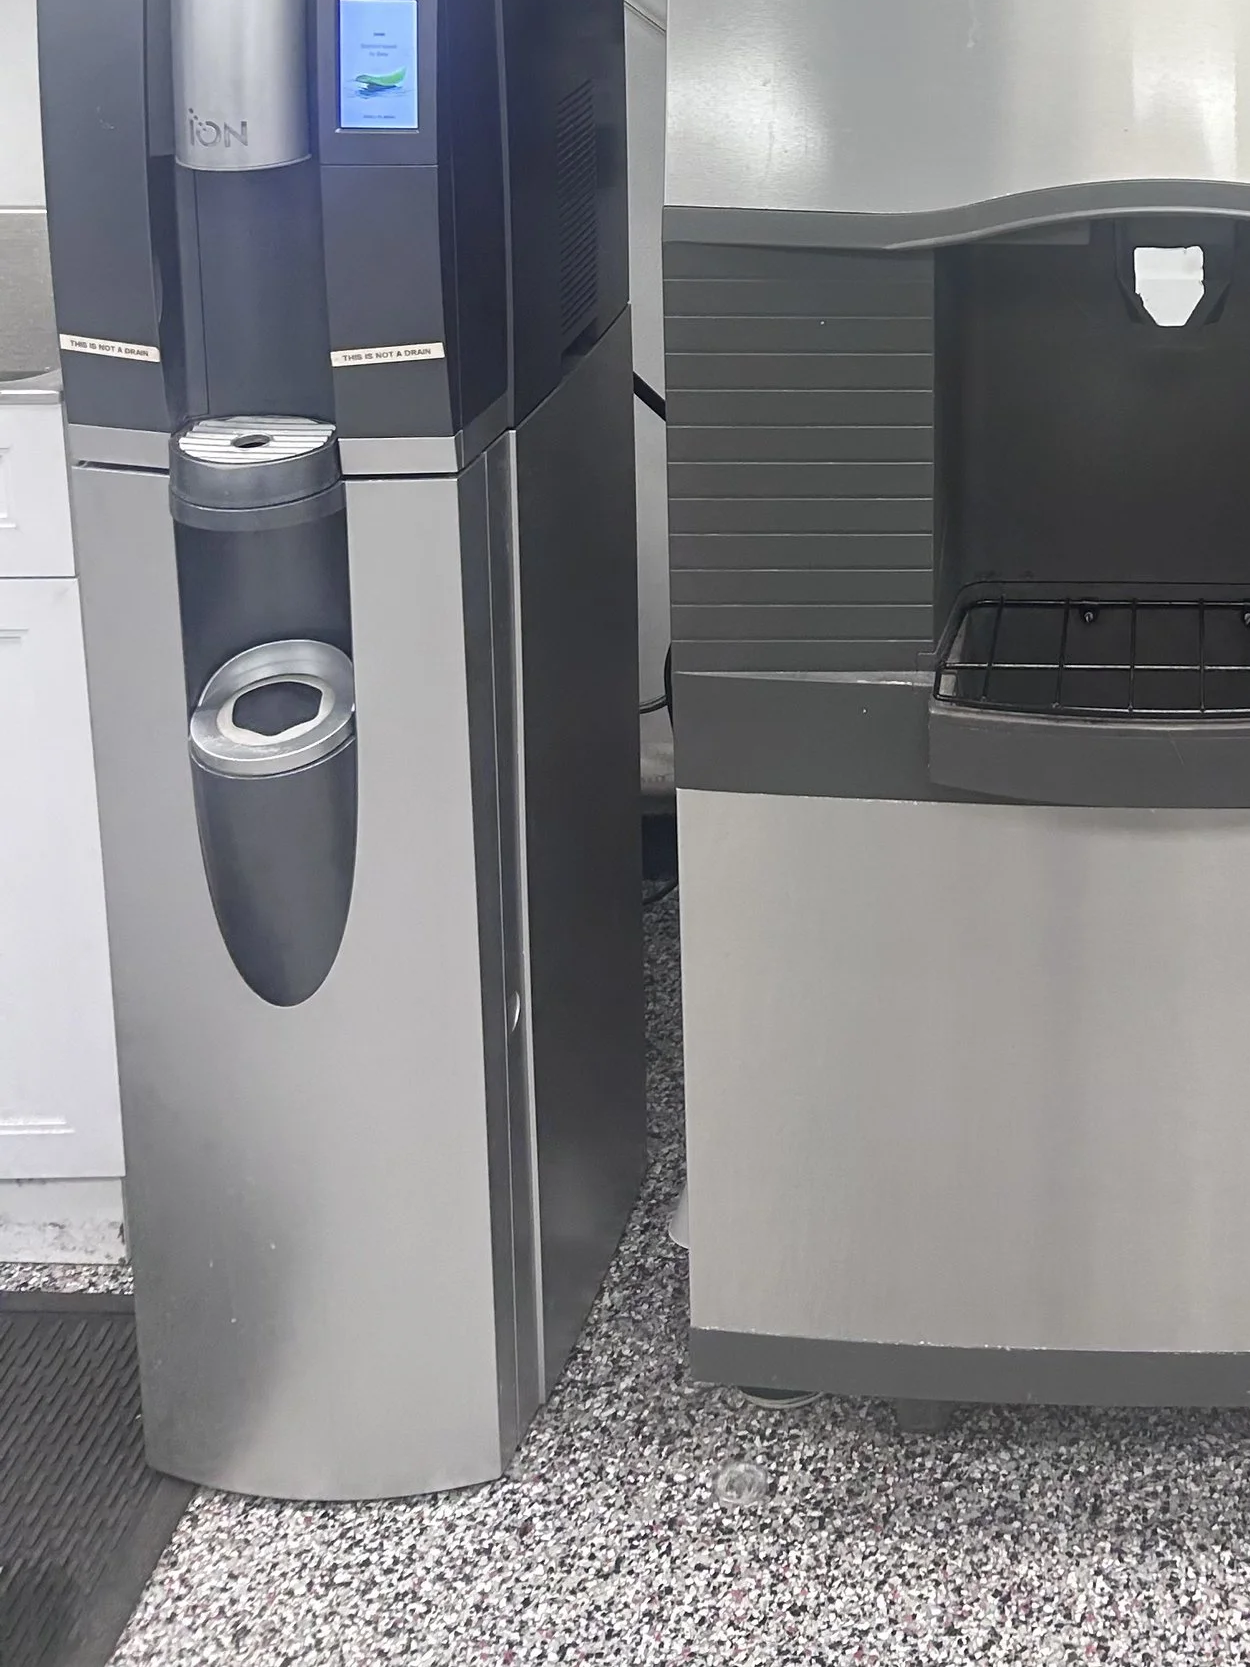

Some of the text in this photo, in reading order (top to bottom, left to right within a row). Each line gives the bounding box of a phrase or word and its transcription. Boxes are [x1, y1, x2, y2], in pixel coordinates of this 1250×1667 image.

[70, 340, 88, 349] THIS
[89, 342, 97, 350] IS
[98, 344, 115, 352] NOT
[124, 348, 149, 357] DRAIN
[375, 351, 393, 359] NOT
[404, 348, 432, 357] DRAIN
